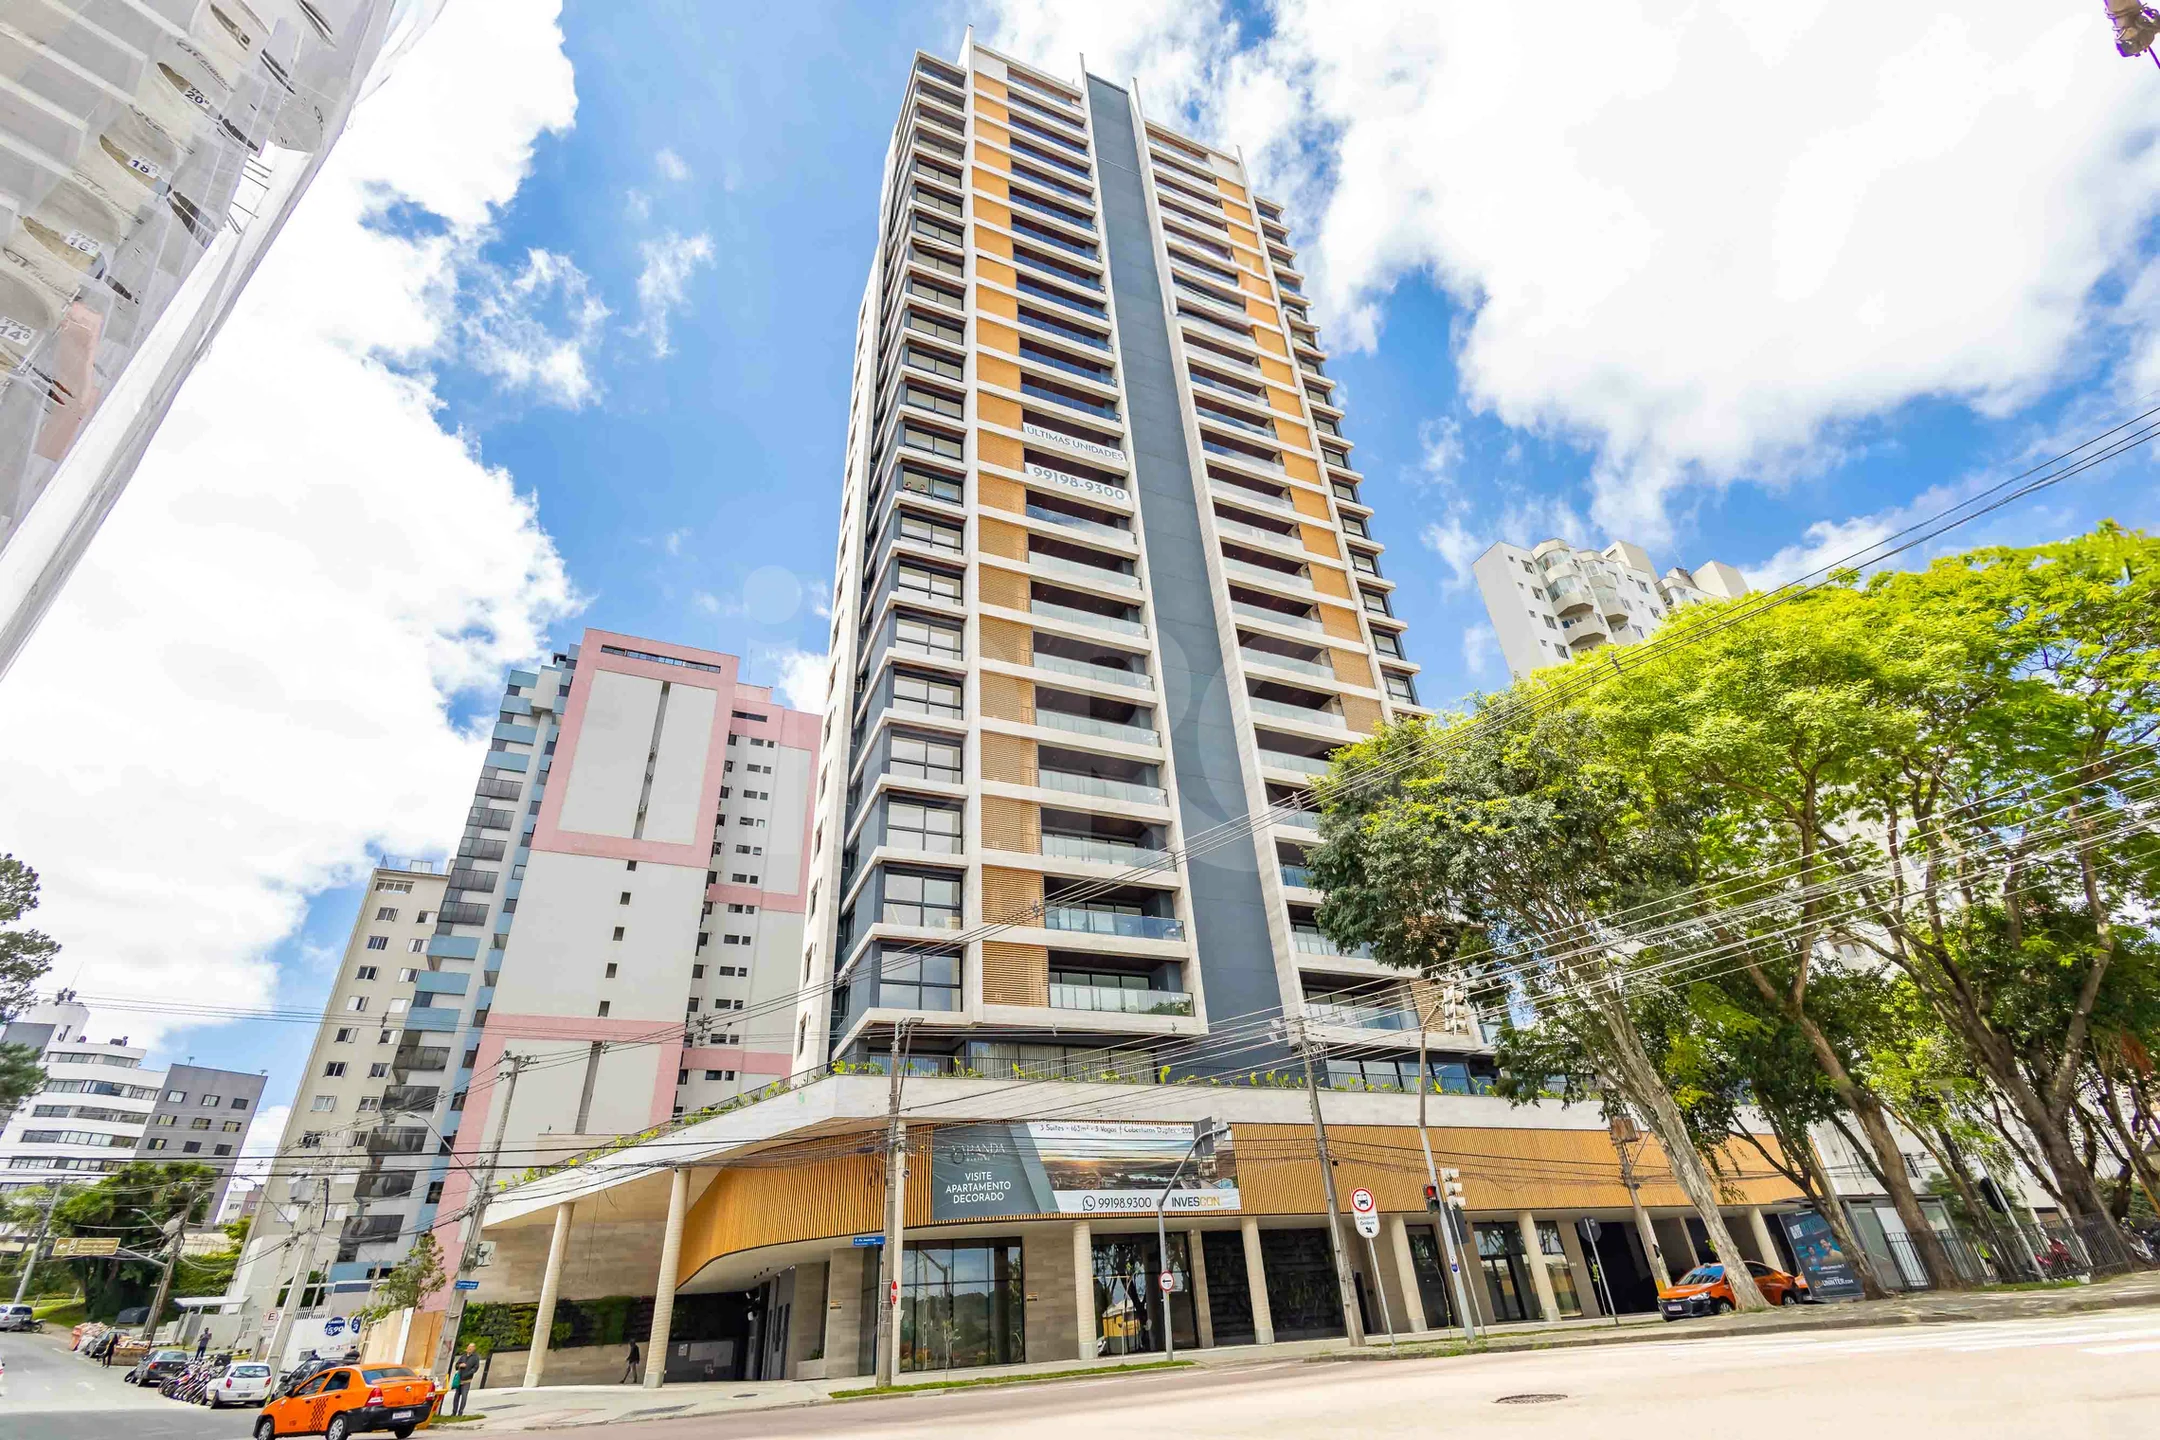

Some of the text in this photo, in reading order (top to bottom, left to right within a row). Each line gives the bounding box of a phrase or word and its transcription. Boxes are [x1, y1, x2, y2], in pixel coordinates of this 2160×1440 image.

[1026, 425, 1124, 461] ÚLTIMAS UNIDADES
[1033, 466, 1126, 500] 99198-9300
[965, 1171, 992, 1181] VISITE
[945, 1181, 1011, 1194] APARTAMENTO
[953, 1191, 1005, 1204] DECORADO
[1098, 1196, 1152, 1209] 99198.9300
[268, 1312, 275, 1321] E
